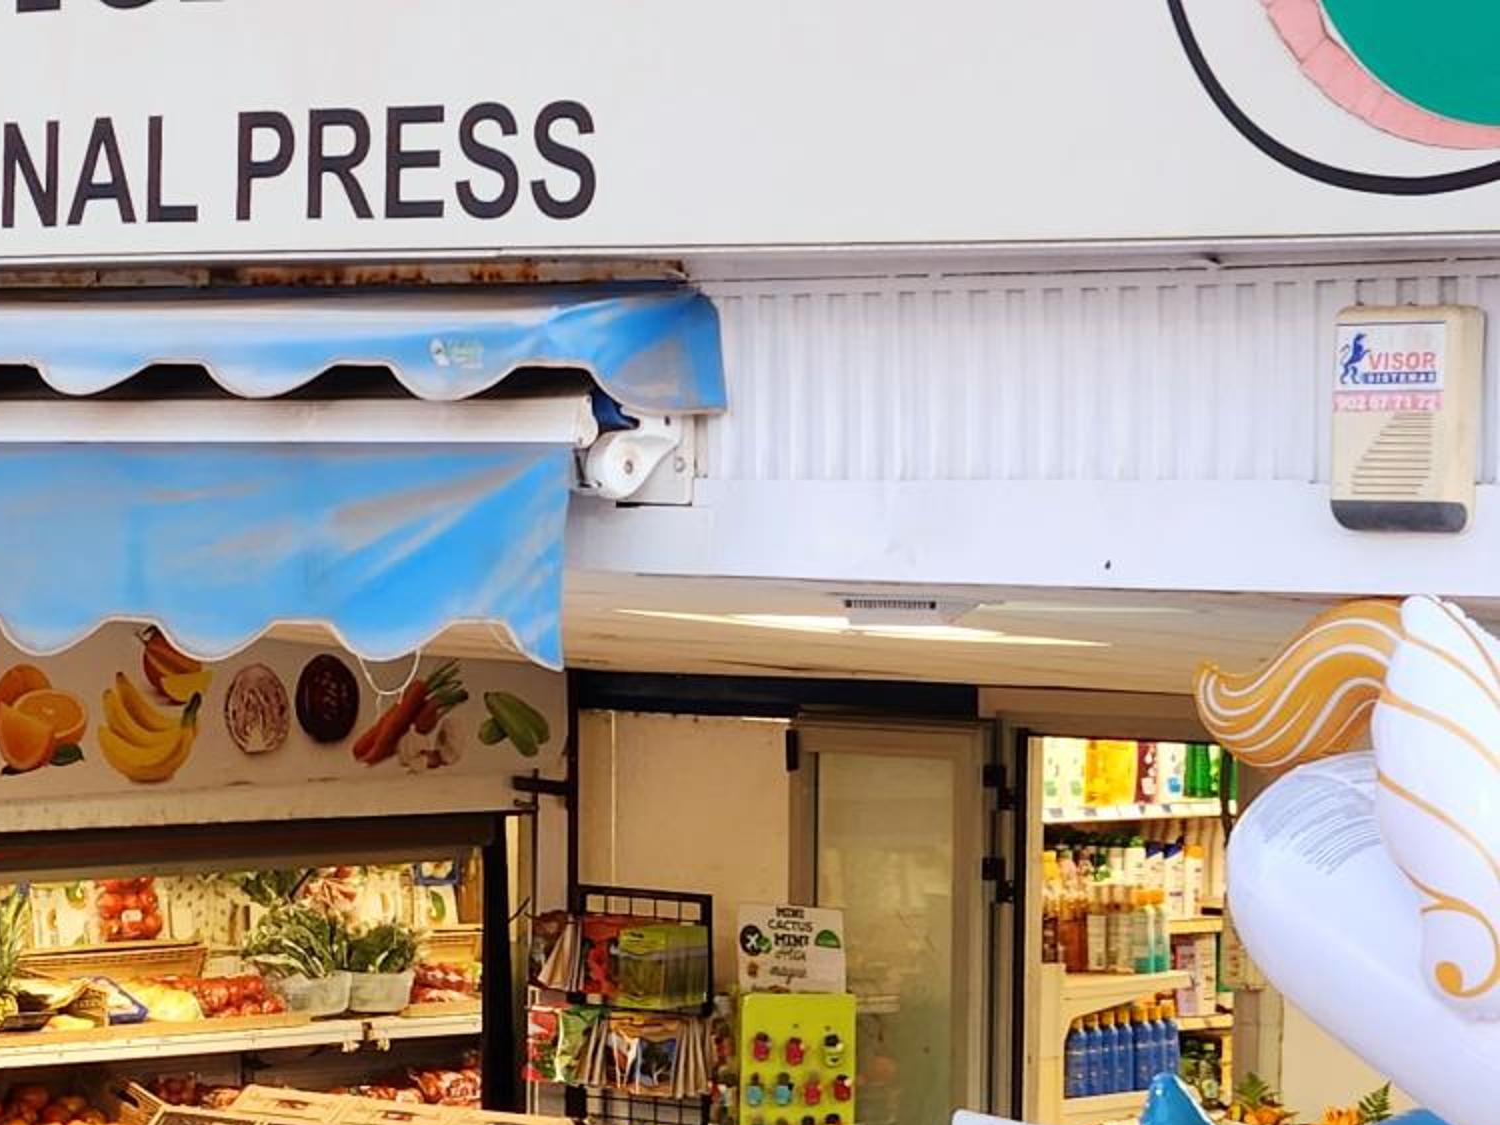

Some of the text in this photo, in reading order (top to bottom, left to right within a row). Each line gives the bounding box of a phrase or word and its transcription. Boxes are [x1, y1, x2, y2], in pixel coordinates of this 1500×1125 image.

[235, 100, 597, 222] PRESS
[1369, 351, 1436, 371] VISOR
[767, 919, 813, 932] CACTUS
